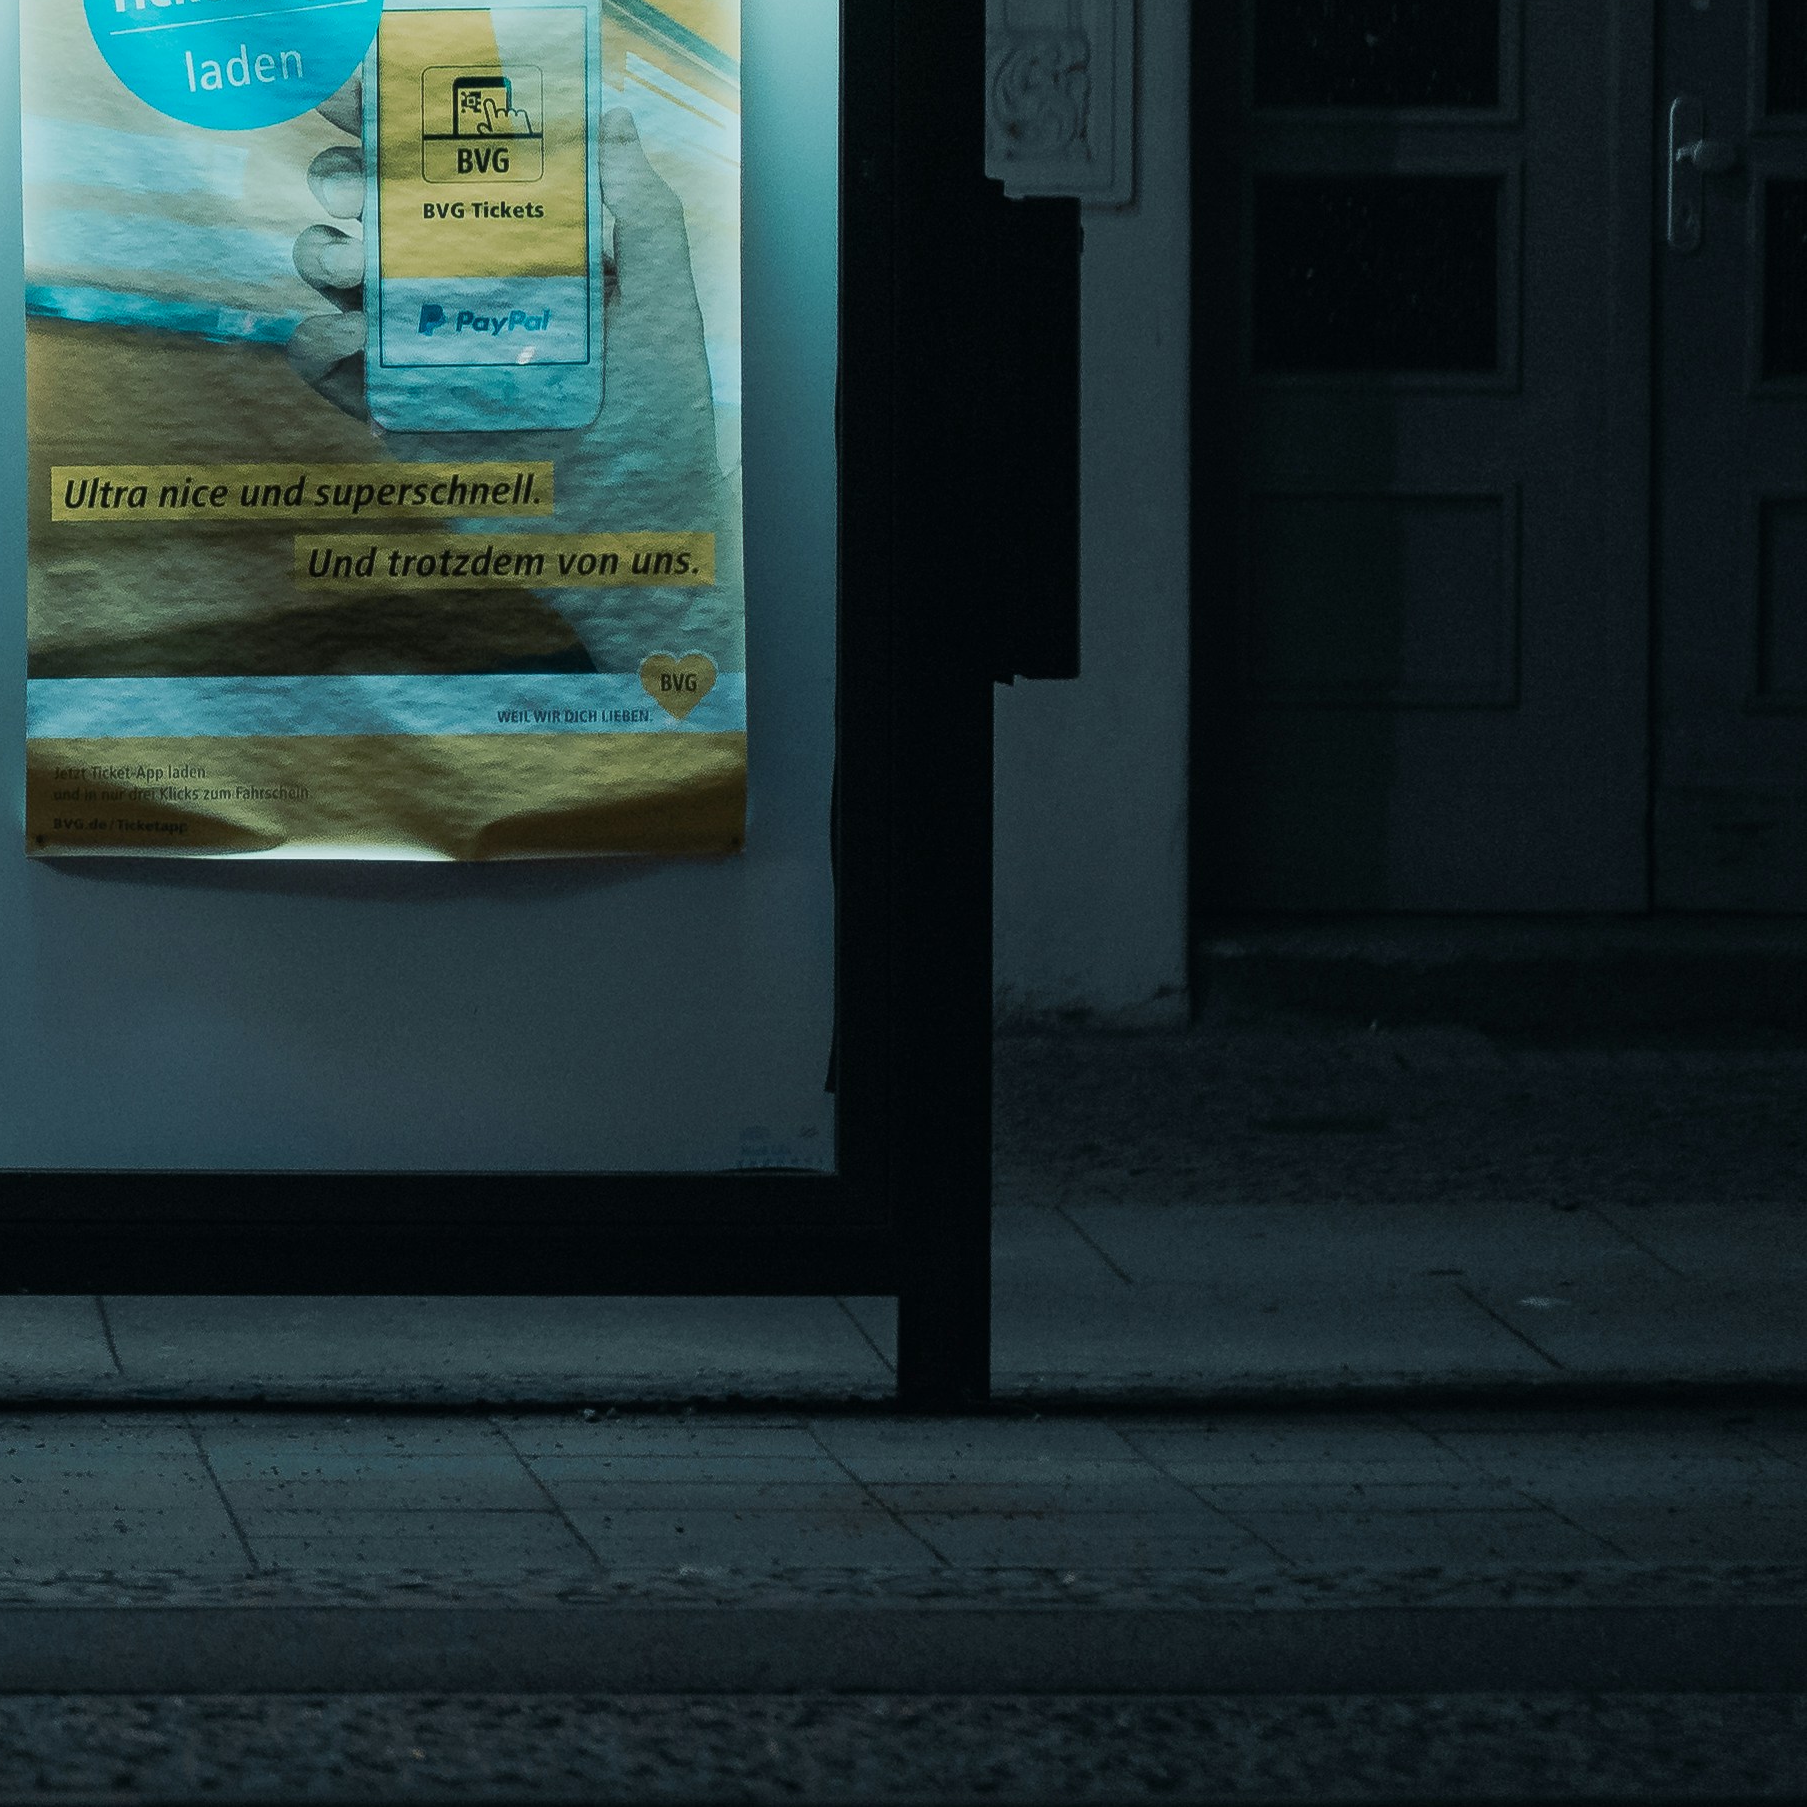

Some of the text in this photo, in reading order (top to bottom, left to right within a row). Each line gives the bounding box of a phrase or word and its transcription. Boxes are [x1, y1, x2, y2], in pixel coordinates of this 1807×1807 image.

[184, 43, 303, 93] laden
[457, 147, 510, 174] BVG
[423, 201, 545, 219] BVG Tickets
[455, 307, 551, 336] PayPal
[63, 472, 542, 514] Ultra nice und superschnell.
[307, 545, 699, 579] Und trotzdem von uns.
[660, 672, 698, 693] BVG
[497, 709, 653, 724] WEIL WIR DICH LIEBEN.
[54, 765, 206, 782] Jetzt Ticket-App laden
[53, 788, 81, 802] und
[159, 786, 199, 801] Klicks
[202, 789, 232, 801] zum
